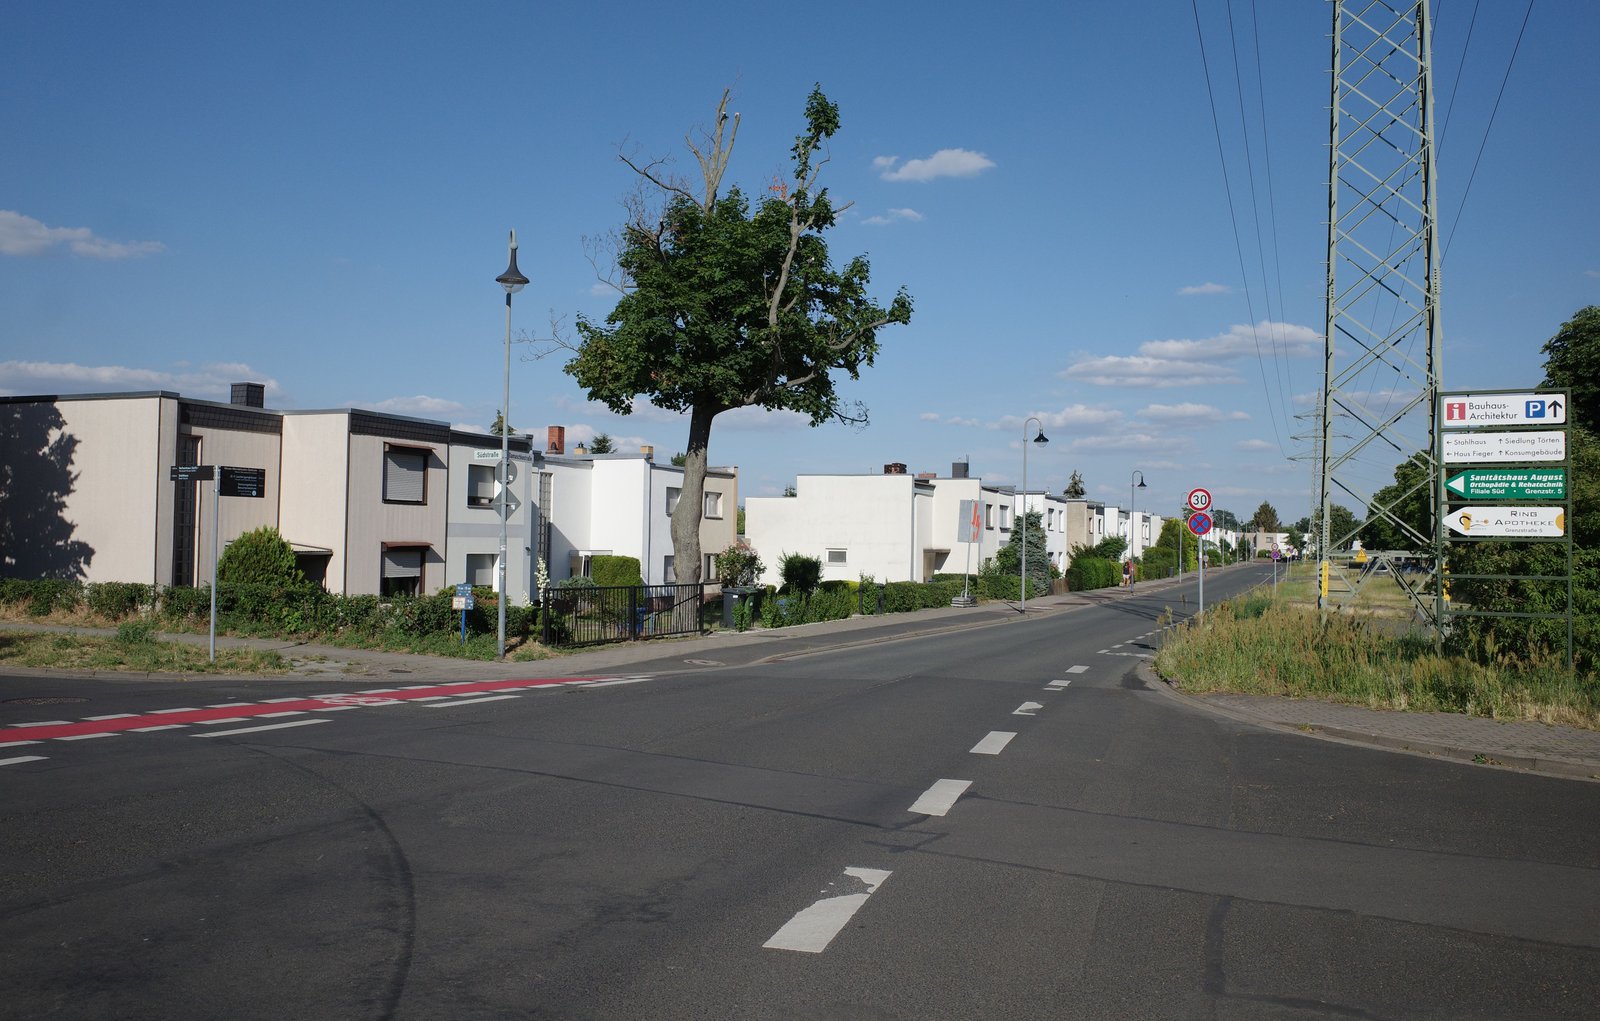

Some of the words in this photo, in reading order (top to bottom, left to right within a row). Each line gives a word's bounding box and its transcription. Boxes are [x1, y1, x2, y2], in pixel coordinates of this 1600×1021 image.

[1469, 402, 1509, 410] Bauhaus-
[1530, 403, 1540, 416] P
[1470, 410, 1517, 420] Architektur
[1193, 494, 1206, 505] 30
